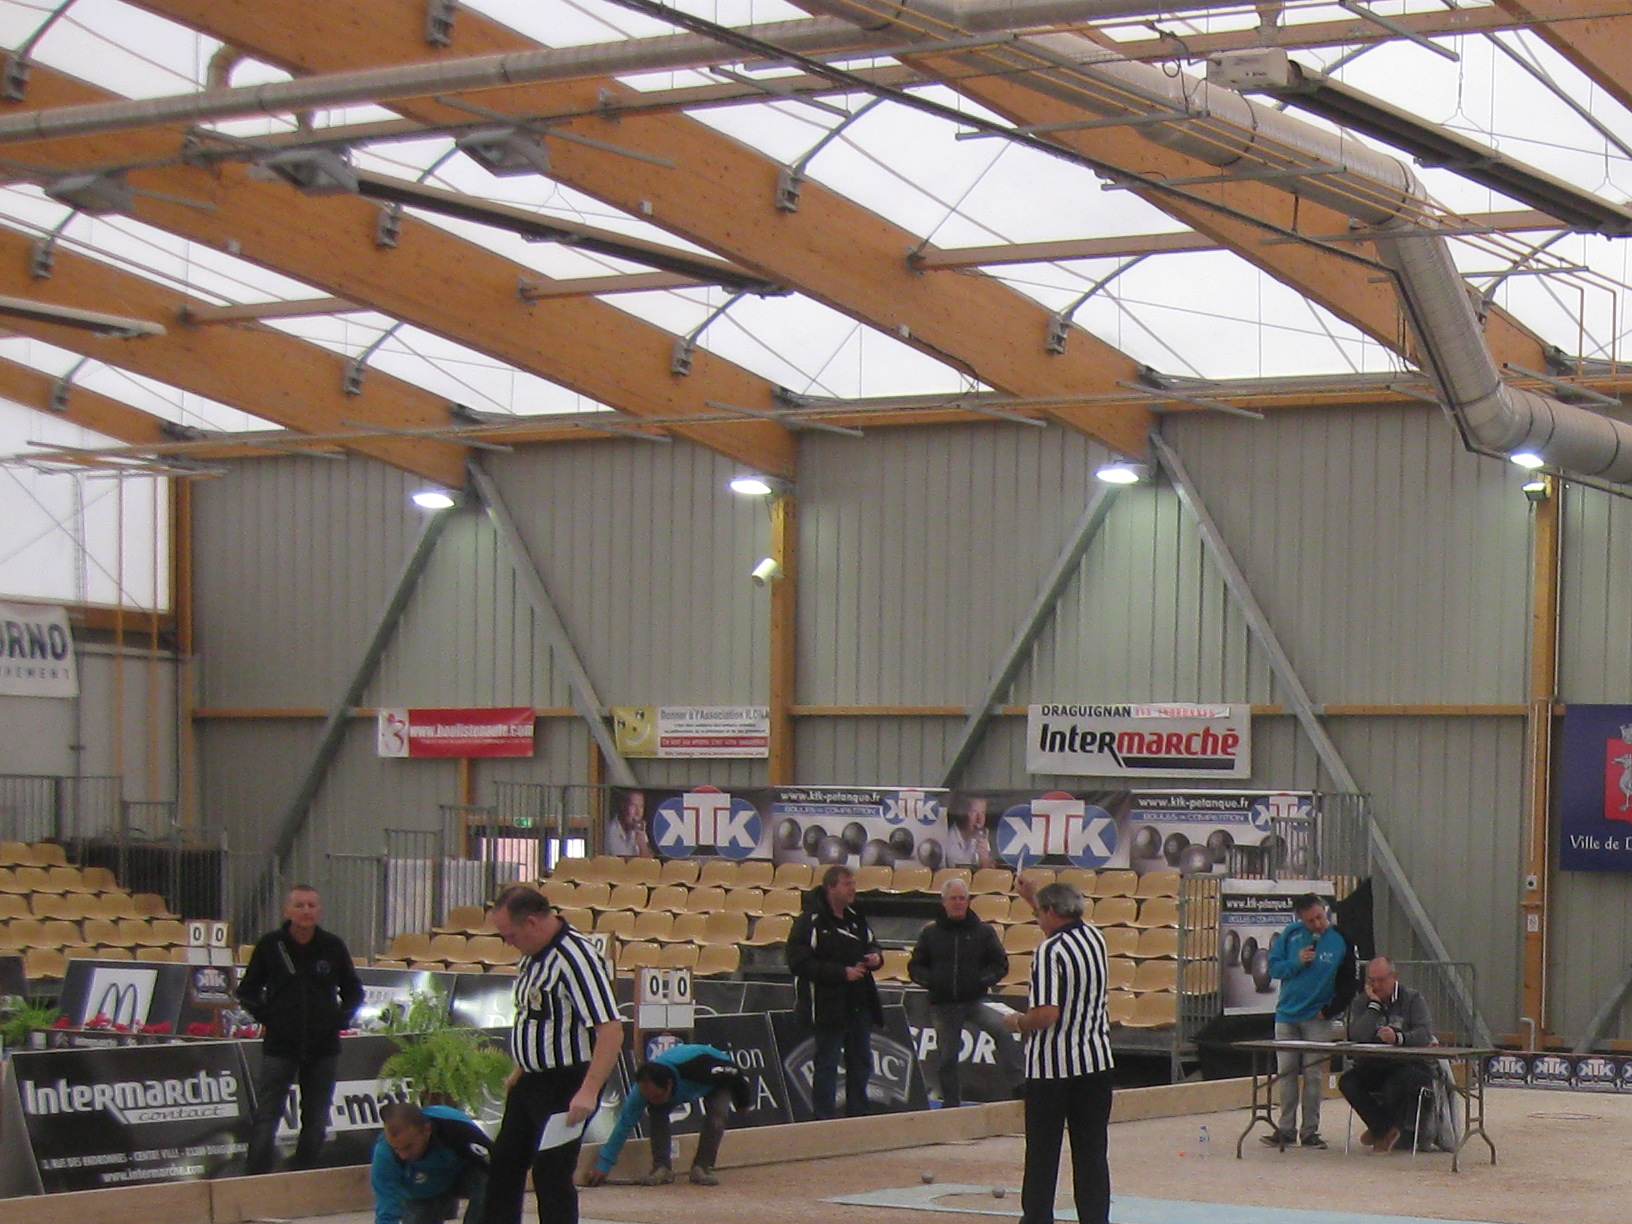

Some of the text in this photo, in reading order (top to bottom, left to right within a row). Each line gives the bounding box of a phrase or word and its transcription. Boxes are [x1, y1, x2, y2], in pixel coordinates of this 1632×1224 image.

[1041, 705, 1131, 717] DRAGUIGNAN
[1039, 724, 1240, 768] Intermarché
[780, 791, 881, 804] www.ktk-petanque.fr
[885, 791, 938, 820] KTK
[1139, 796, 1250, 810] www.ktk-petanque.fr
[659, 793, 757, 847] KTK
[1004, 800, 1113, 857] KTK
[1569, 834, 1600, 850] Ville
[1604, 836, 1620, 851] de
[193, 926, 224, 942] 0 0
[650, 975, 688, 997] 0 0
[21, 1070, 239, 1125] Intermarché
[138, 1105, 225, 1121] contact
